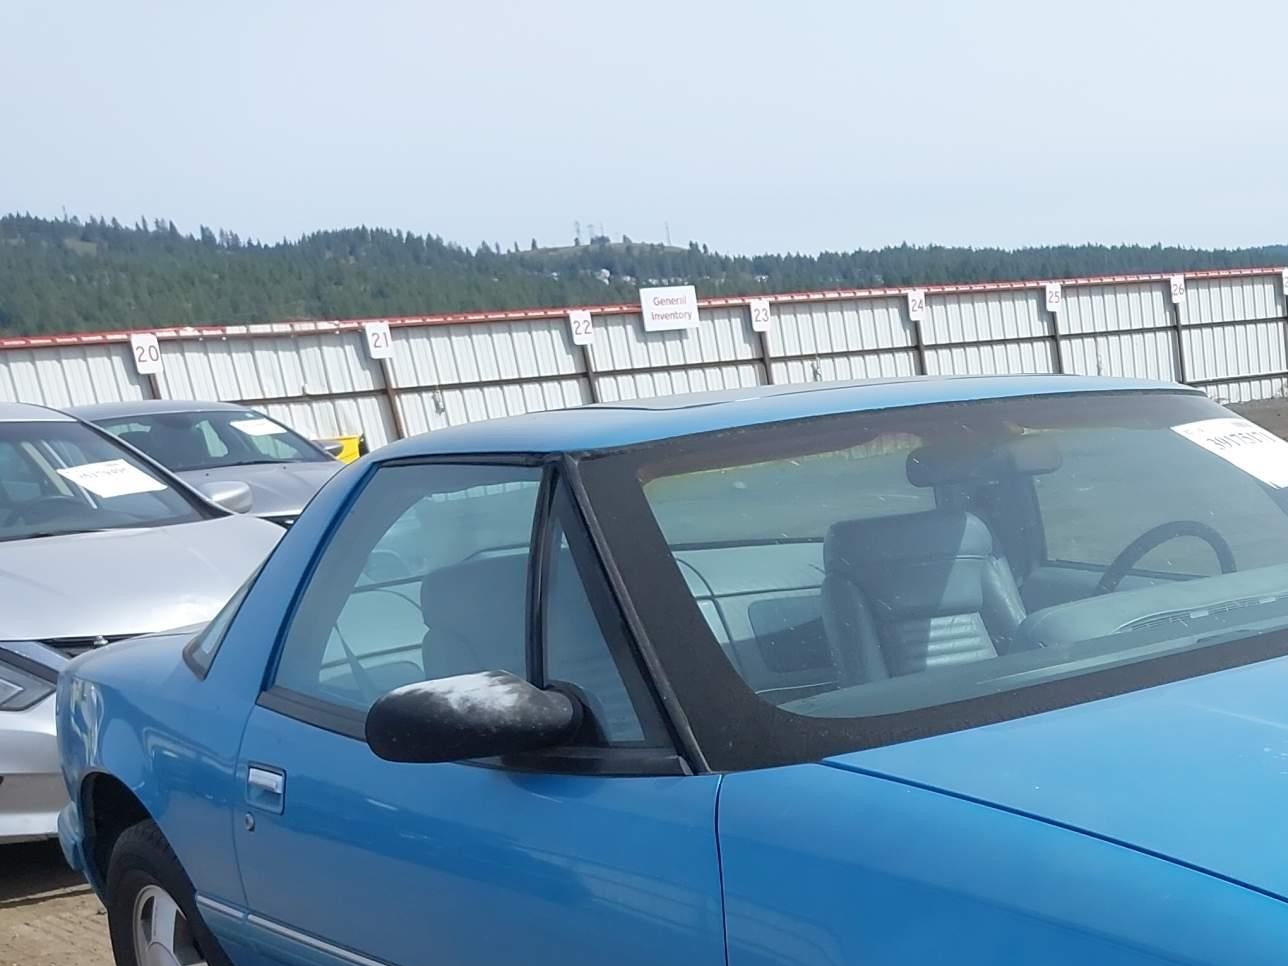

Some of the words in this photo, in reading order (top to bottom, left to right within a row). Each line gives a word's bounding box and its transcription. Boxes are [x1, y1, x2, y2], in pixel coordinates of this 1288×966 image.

[1171, 283, 1185, 296] 26
[652, 295, 687, 306] General
[1048, 290, 1061, 304] 25
[911, 298, 924, 312] 24
[650, 310, 693, 321] Inventory
[753, 307, 770, 323] 23
[572, 319, 593, 336] 22
[371, 331, 390, 349] 21
[136, 345, 160, 363] 20
